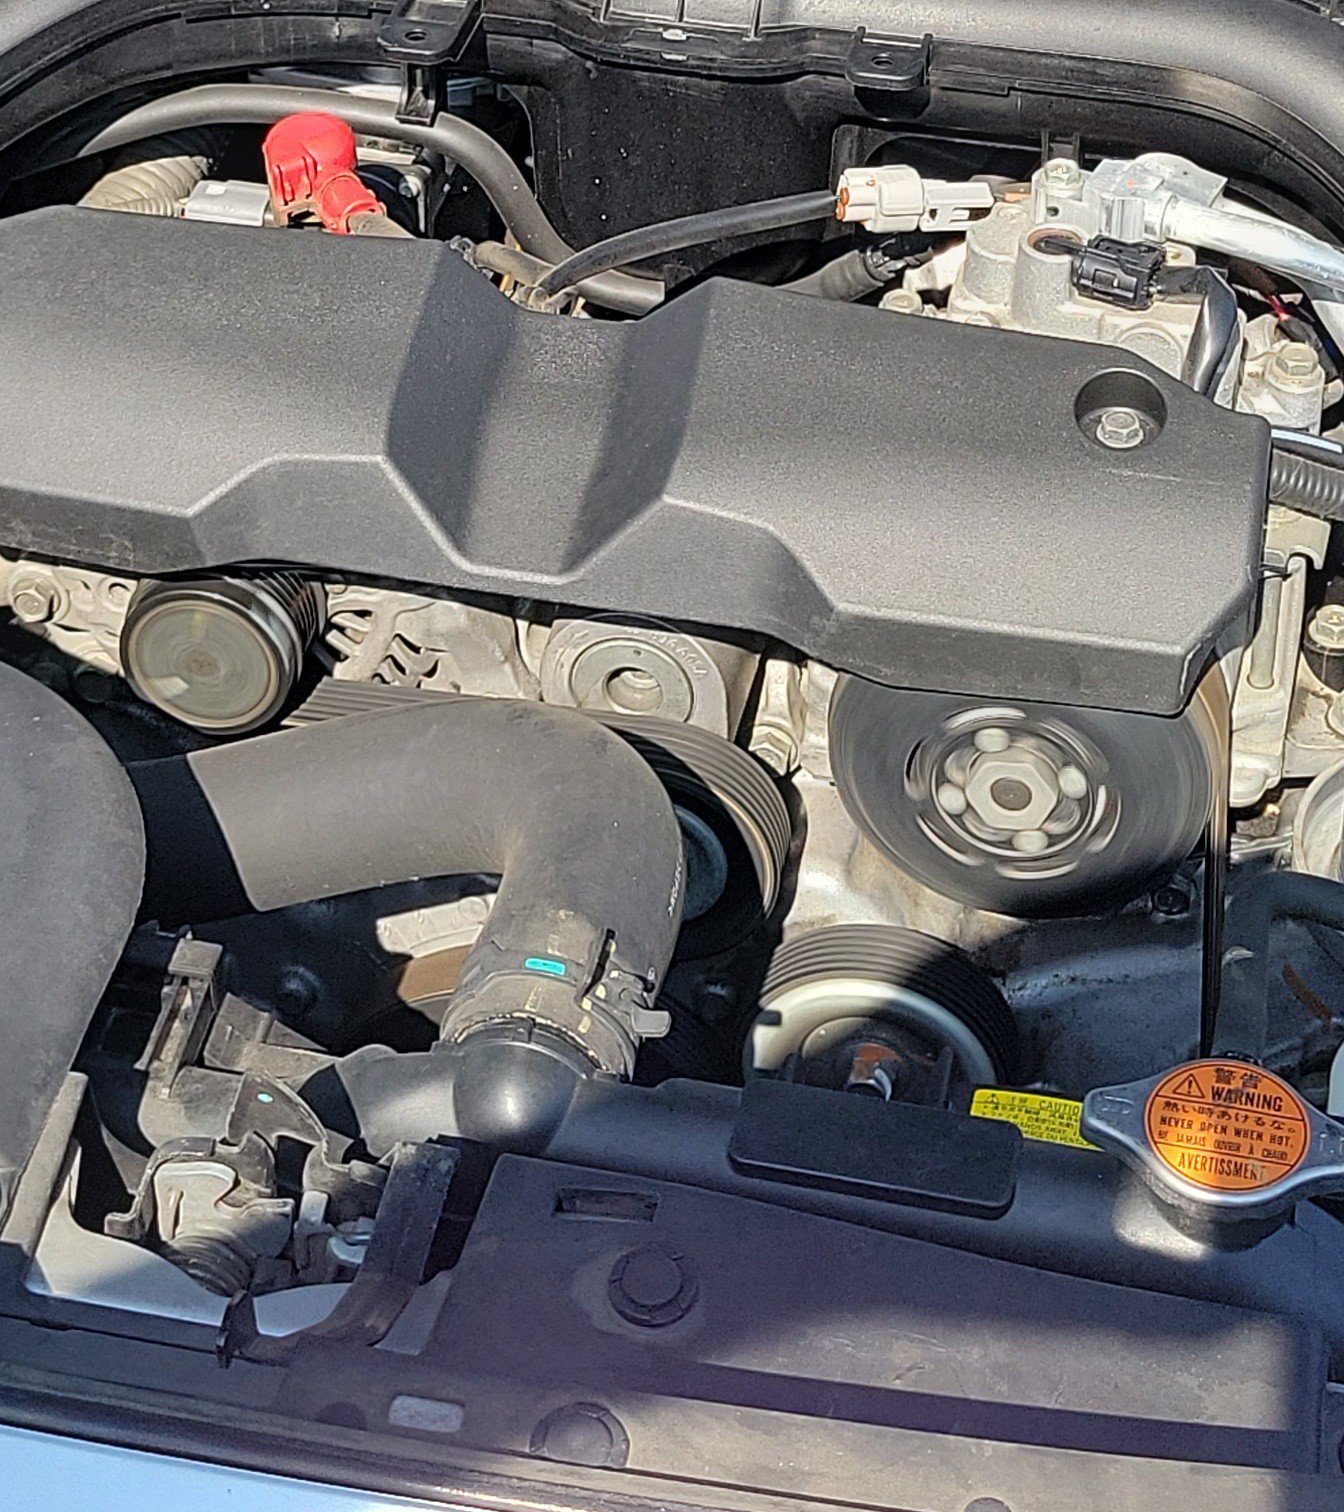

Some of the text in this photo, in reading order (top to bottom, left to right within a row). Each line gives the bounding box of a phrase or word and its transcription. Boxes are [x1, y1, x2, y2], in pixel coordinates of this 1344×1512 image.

[1214, 1067, 1262, 1089] 警告
[1039, 1099, 1080, 1115] CAUTIO
[1211, 1085, 1283, 1112] WARNING
[1159, 1115, 1193, 1129] NEVER
[1200, 1122, 1228, 1135] OPEN
[1234, 1127, 1263, 1141] WHEN
